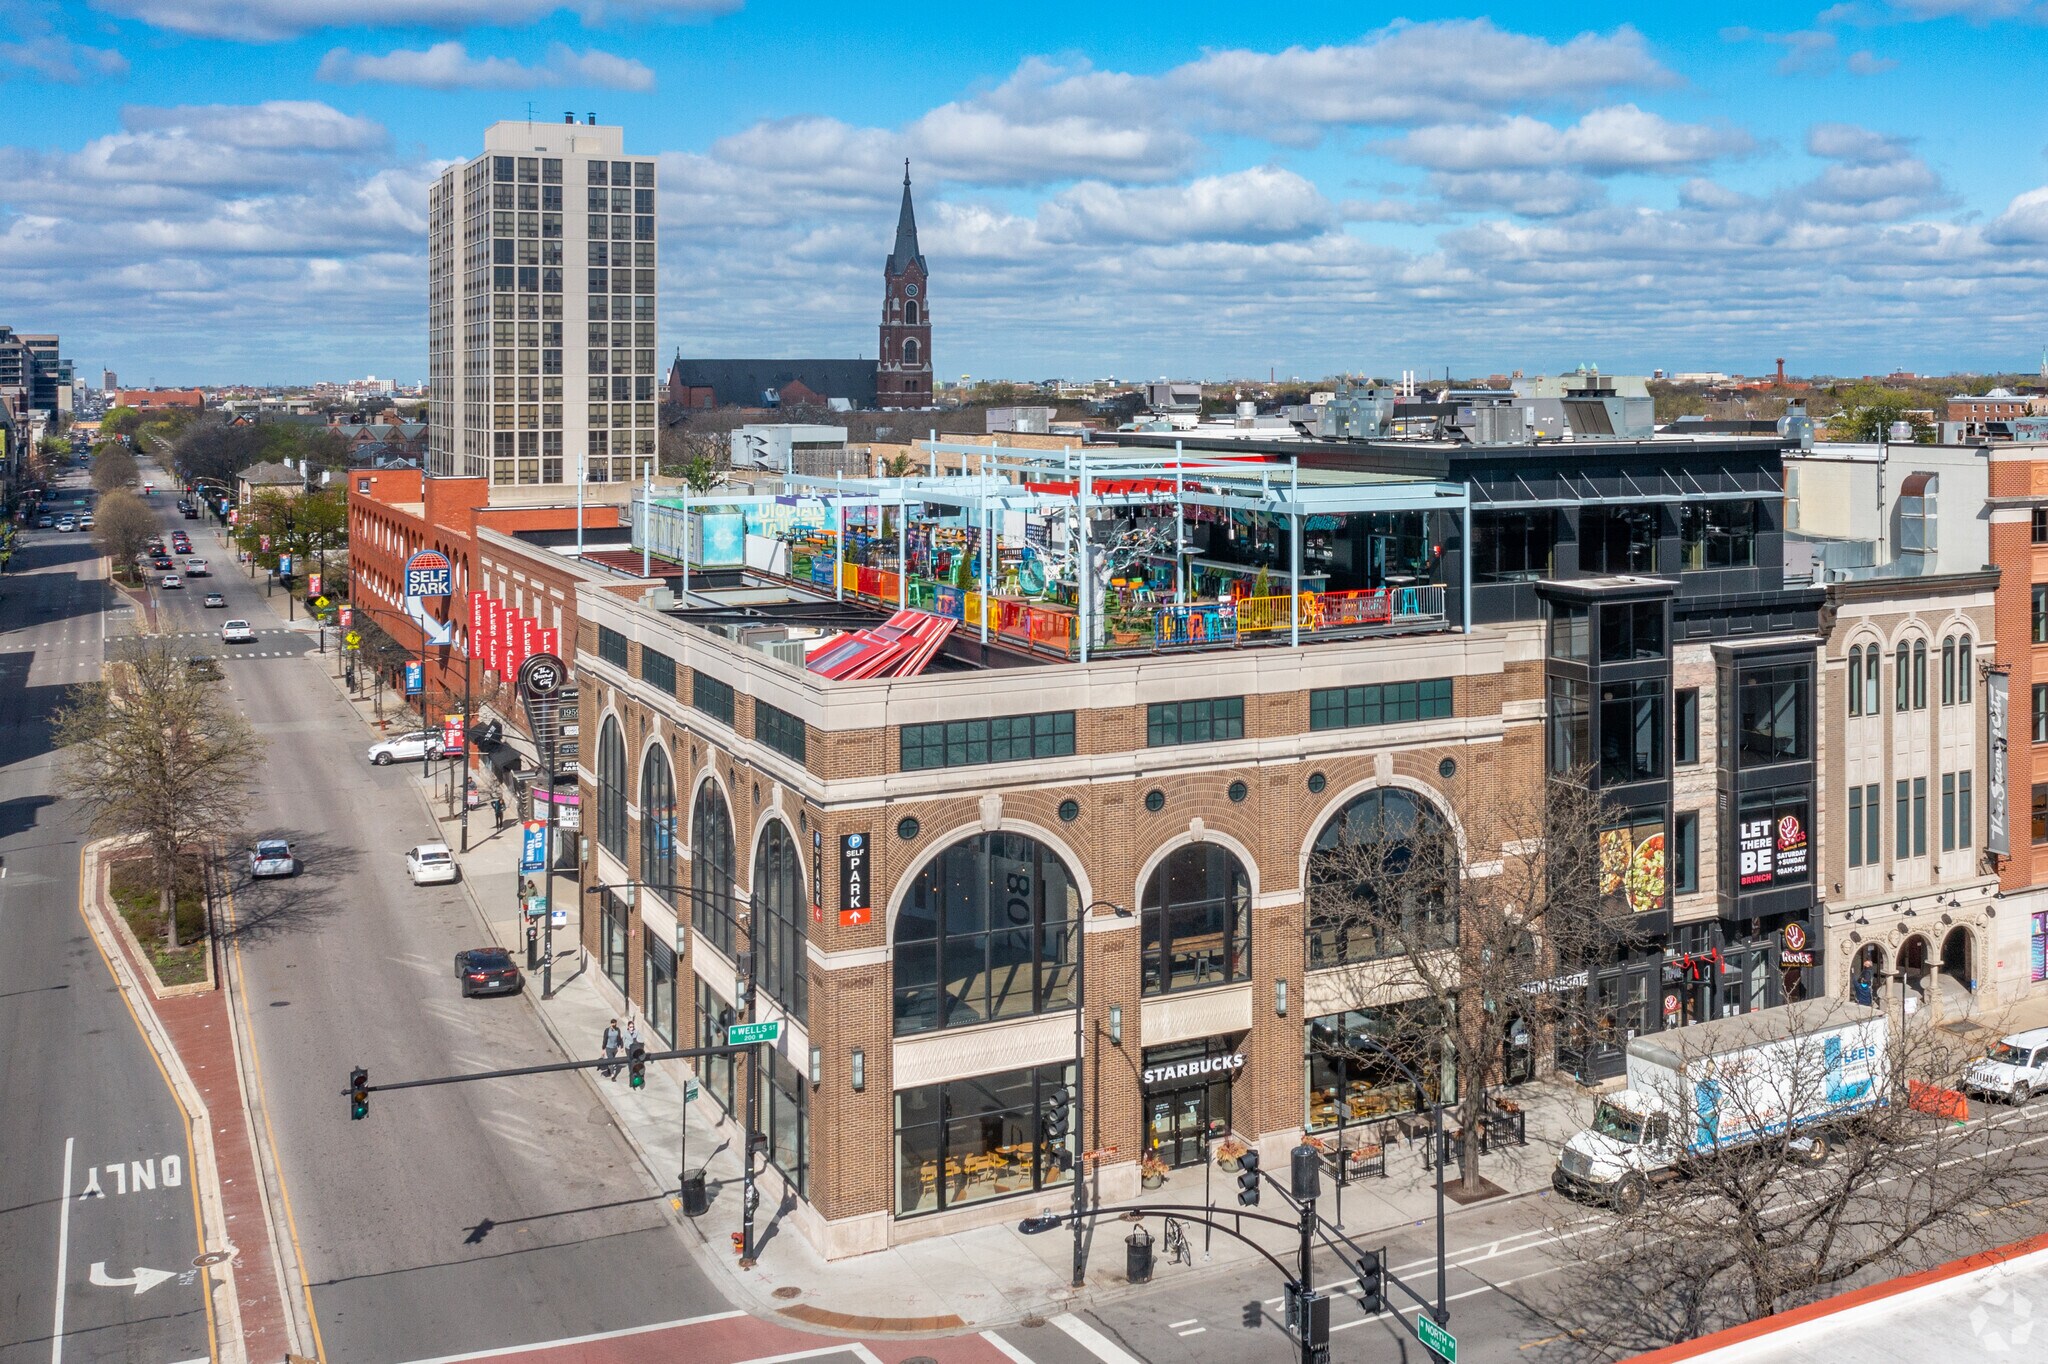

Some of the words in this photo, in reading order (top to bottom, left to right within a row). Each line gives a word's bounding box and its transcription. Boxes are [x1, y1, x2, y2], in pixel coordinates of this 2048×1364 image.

[409, 569, 448, 583] SELF
[409, 581, 449, 595] PARK
[474, 593, 482, 627] PIPERS
[489, 601, 497, 637] PIPERS
[506, 611, 514, 647] PIPERS
[490, 639, 498, 668] ALLEY
[543, 631, 551, 653] PIP
[506, 649, 514, 680] ALLEY
[1989, 683, 2009, 729] City
[1740, 819, 1772, 840] LET
[1990, 801, 2005, 841] The
[526, 838, 535, 862] TOWN
[534, 832, 543, 848] OLD
[1740, 836, 1773, 851] THERE
[845, 848, 865, 858] SELF
[1740, 848, 1772, 876] BE
[1776, 848, 1807, 861] SATURDAY
[849, 857, 861, 909] PARK
[1741, 873, 1772, 886] BRUNCH
[1781, 950, 1813, 964] Roots
[738, 1025, 767, 1035] WELLS
[1143, 1053, 1244, 1084] STARBUCKS
[79, 1154, 182, 1201] ONLY
[1425, 1322, 1447, 1345] NORTH
